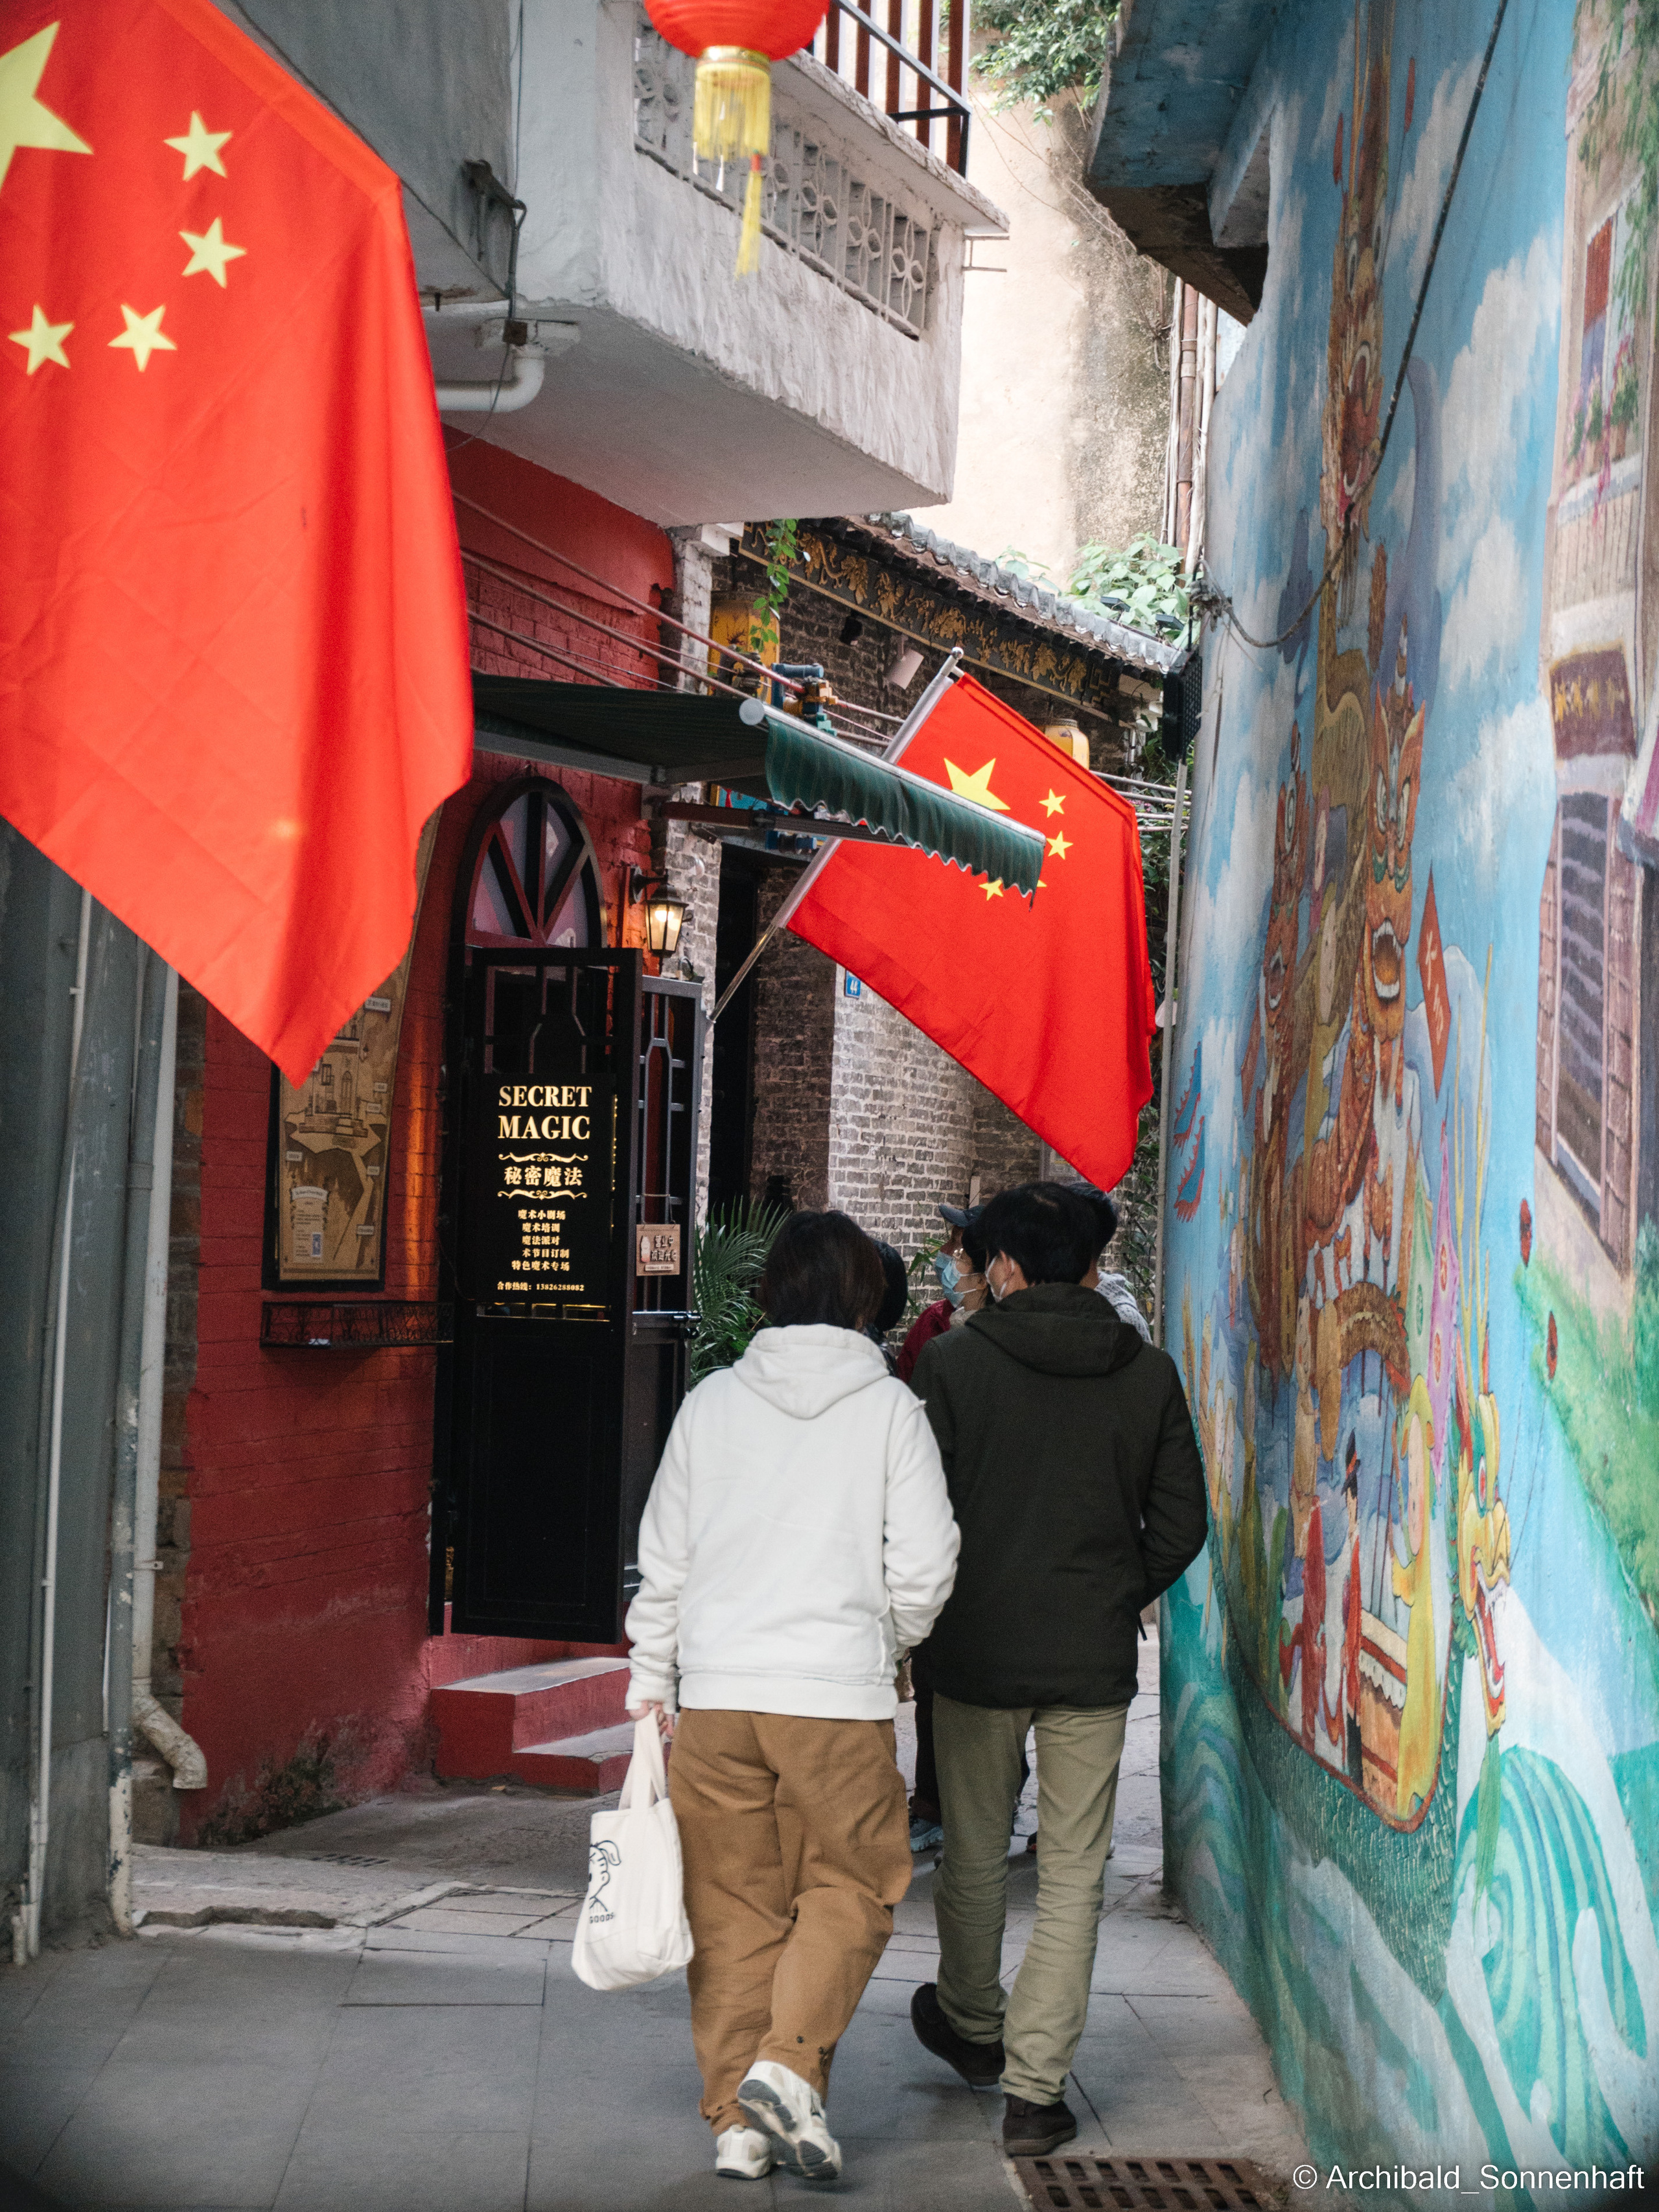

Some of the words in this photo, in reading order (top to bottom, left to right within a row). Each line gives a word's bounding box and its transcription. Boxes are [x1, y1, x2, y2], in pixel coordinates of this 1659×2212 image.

[850, 979, 858, 994] 44
[498, 1085, 592, 1108] SECRET
[497, 1115, 590, 1140] MAGIC
[504, 1165, 583, 1187] 秘密魔法
[518, 1209, 566, 1220] 魔术小剧场
[522, 1222, 561, 1233] 魔术培训
[522, 1235, 561, 1246] 魔法派对
[511, 1260, 570, 1272] 特色魔术专场
[536, 1283, 585, 1292] 13826288082
